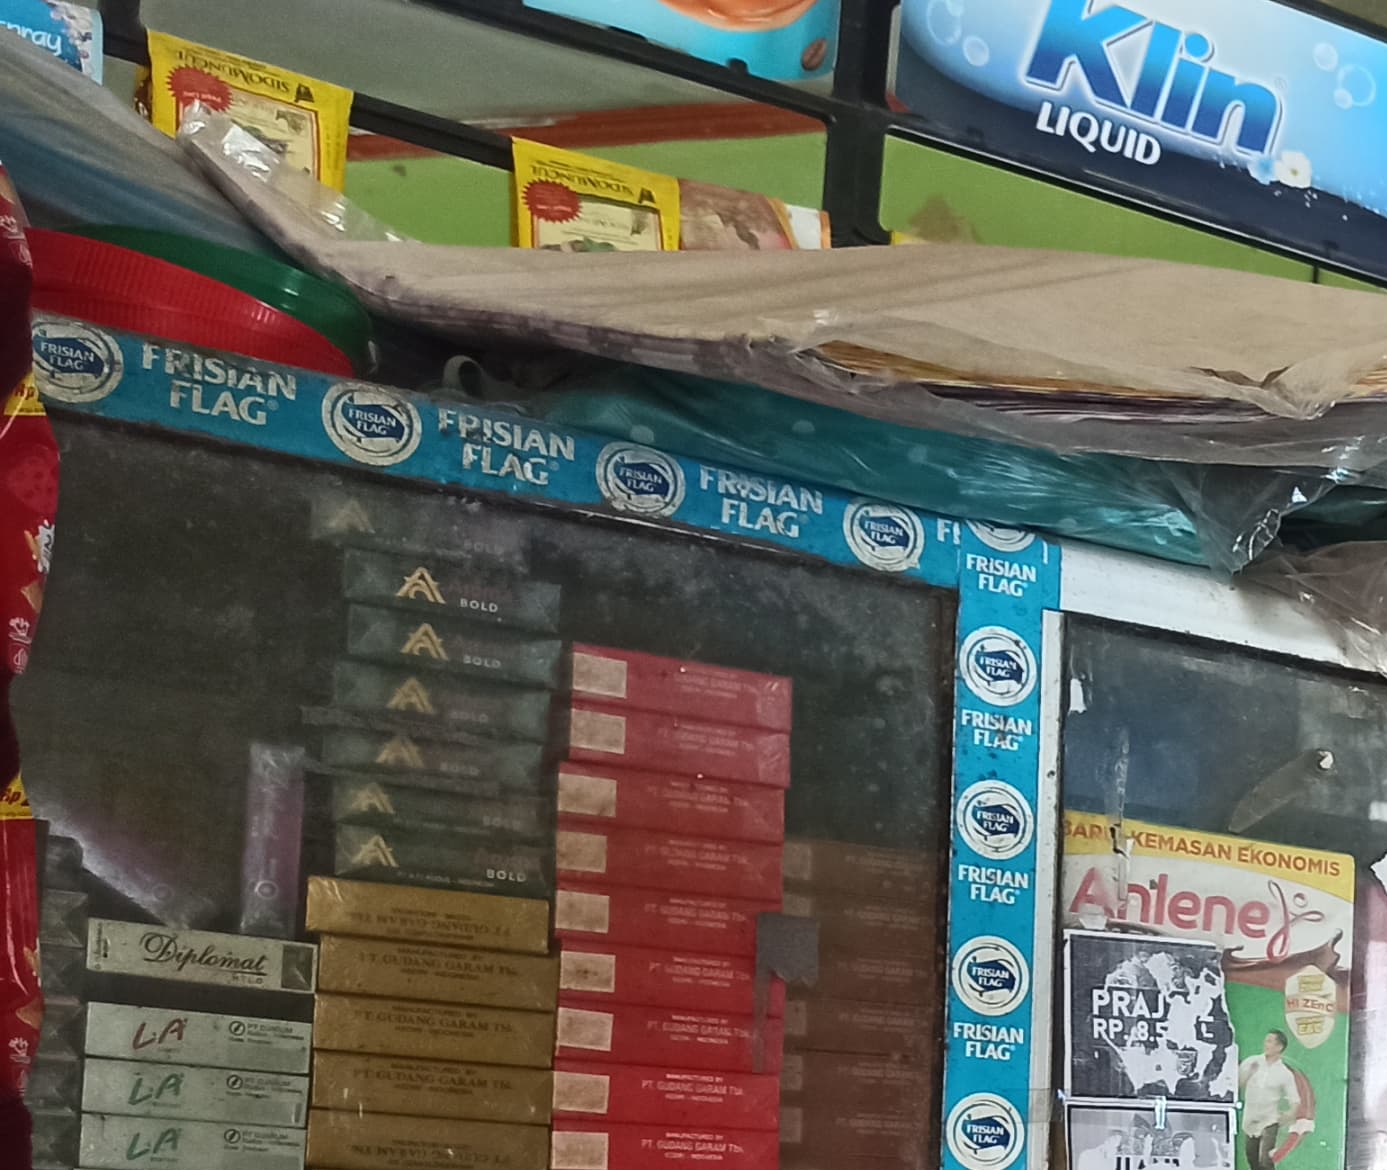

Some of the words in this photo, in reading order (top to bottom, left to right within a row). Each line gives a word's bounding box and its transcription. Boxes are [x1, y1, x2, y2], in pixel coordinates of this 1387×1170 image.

[1025, 0, 1284, 156] Klin
[1036, 101, 1161, 167] LIQUID
[40, 342, 94, 363] FRISIAN
[49, 355, 85, 371] FLAG
[142, 343, 296, 401] FRISIAN
[170, 379, 267, 425] FLAG
[437, 408, 576, 461] FRISIAN
[461, 443, 549, 487] FLAG
[699, 465, 823, 515] FRISIAN
[721, 496, 800, 539] FLAG
[966, 553, 1036, 583] FRISIAN
[978, 573, 1025, 598] FLAG
[460, 598, 498, 614] BOLD
[962, 709, 1032, 736] FRISIAN
[974, 729, 1019, 751] FLAG
[1063, 821, 1108, 839] BAR
[1131, 831, 1231, 861] KEMASAN
[1237, 845, 1341, 876] EKONOMIS
[486, 868, 527, 883] BOLD
[959, 864, 1029, 888] FRISIAN
[970, 884, 1016, 905] FLAG
[1069, 867, 1271, 939] Anlene
[138, 930, 268, 976] Diplomat
[1092, 989, 1167, 1018] PRAJ
[953, 1023, 1024, 1044] FRISIAN
[965, 1040, 1011, 1061] FLAG
